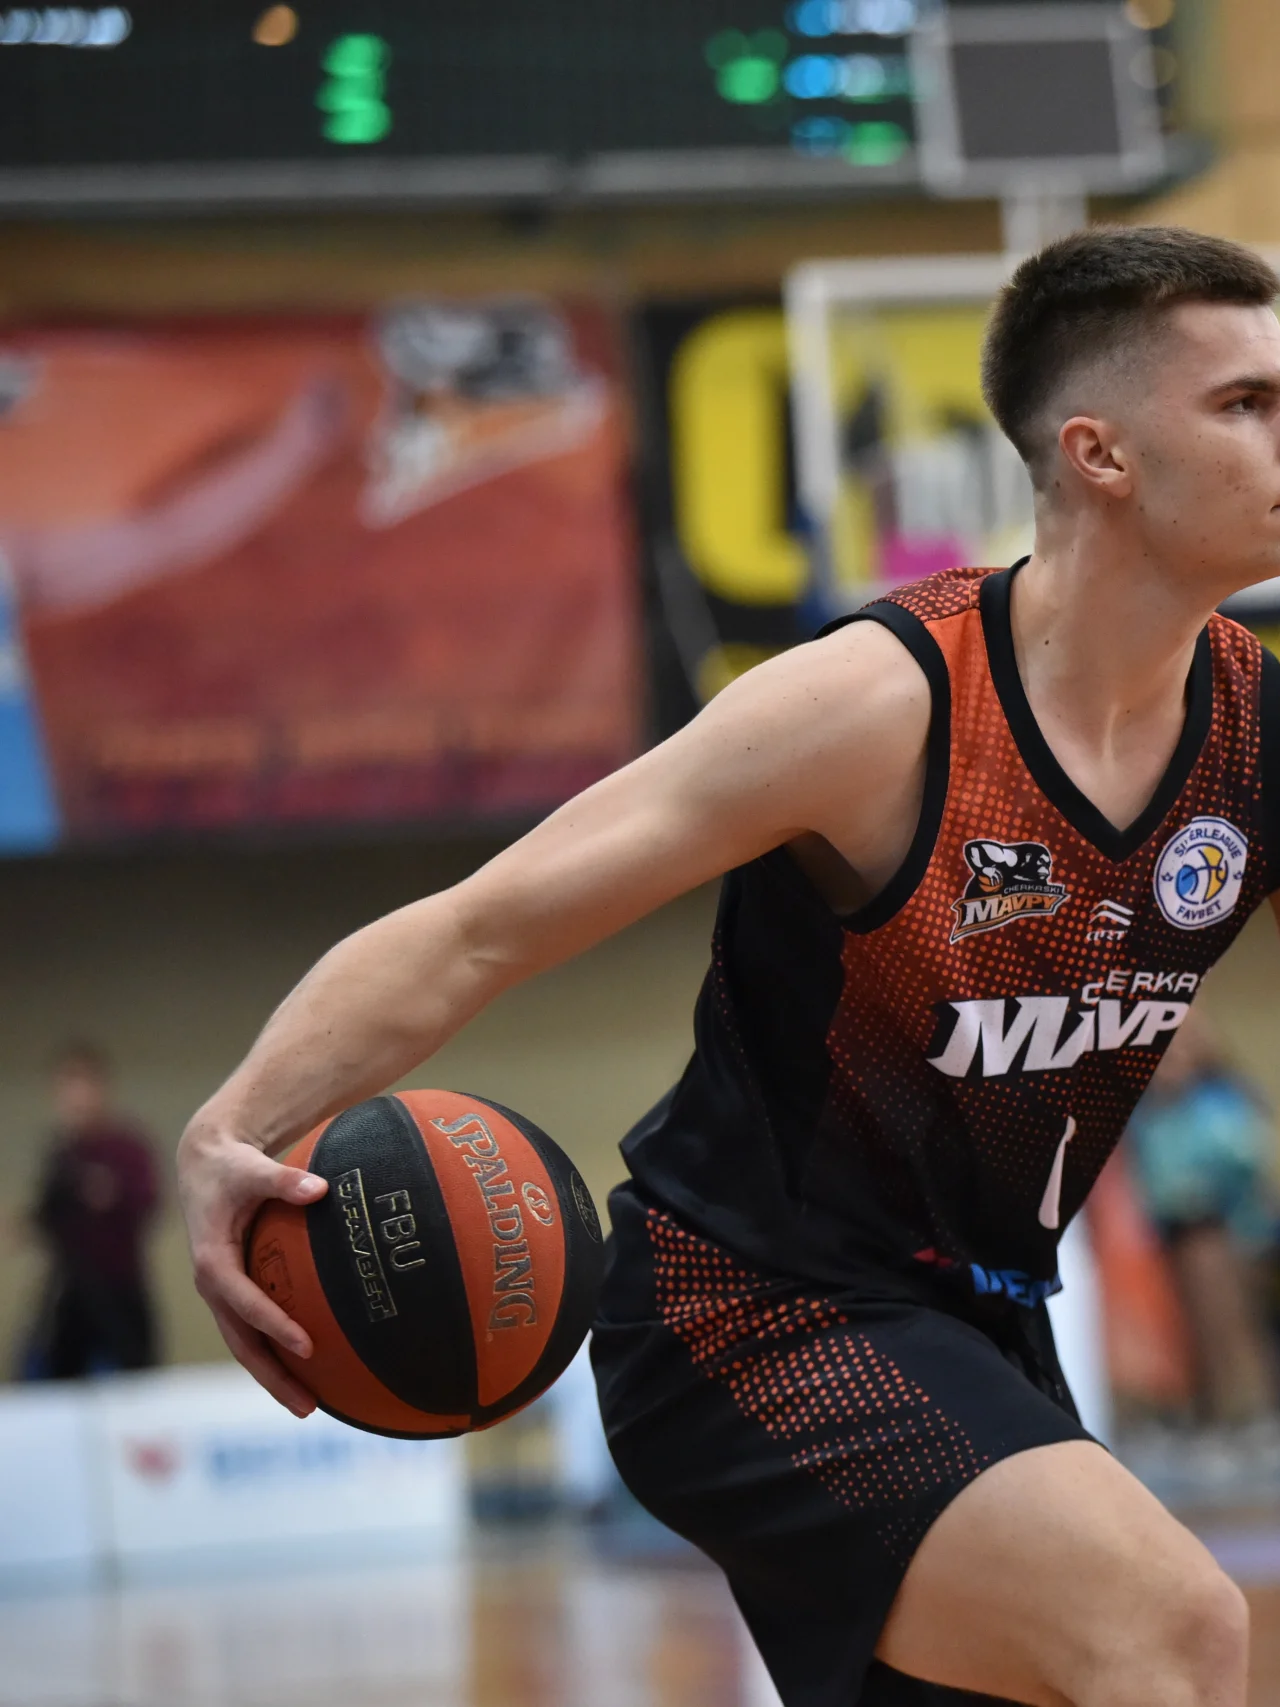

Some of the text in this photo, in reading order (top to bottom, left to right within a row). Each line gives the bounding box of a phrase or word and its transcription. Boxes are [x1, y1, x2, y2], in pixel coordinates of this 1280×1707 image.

[960, 895, 1058, 928] MAVPY
[374, 1189, 426, 1271] FBU
[429, 1112, 540, 1332] SPALDING
